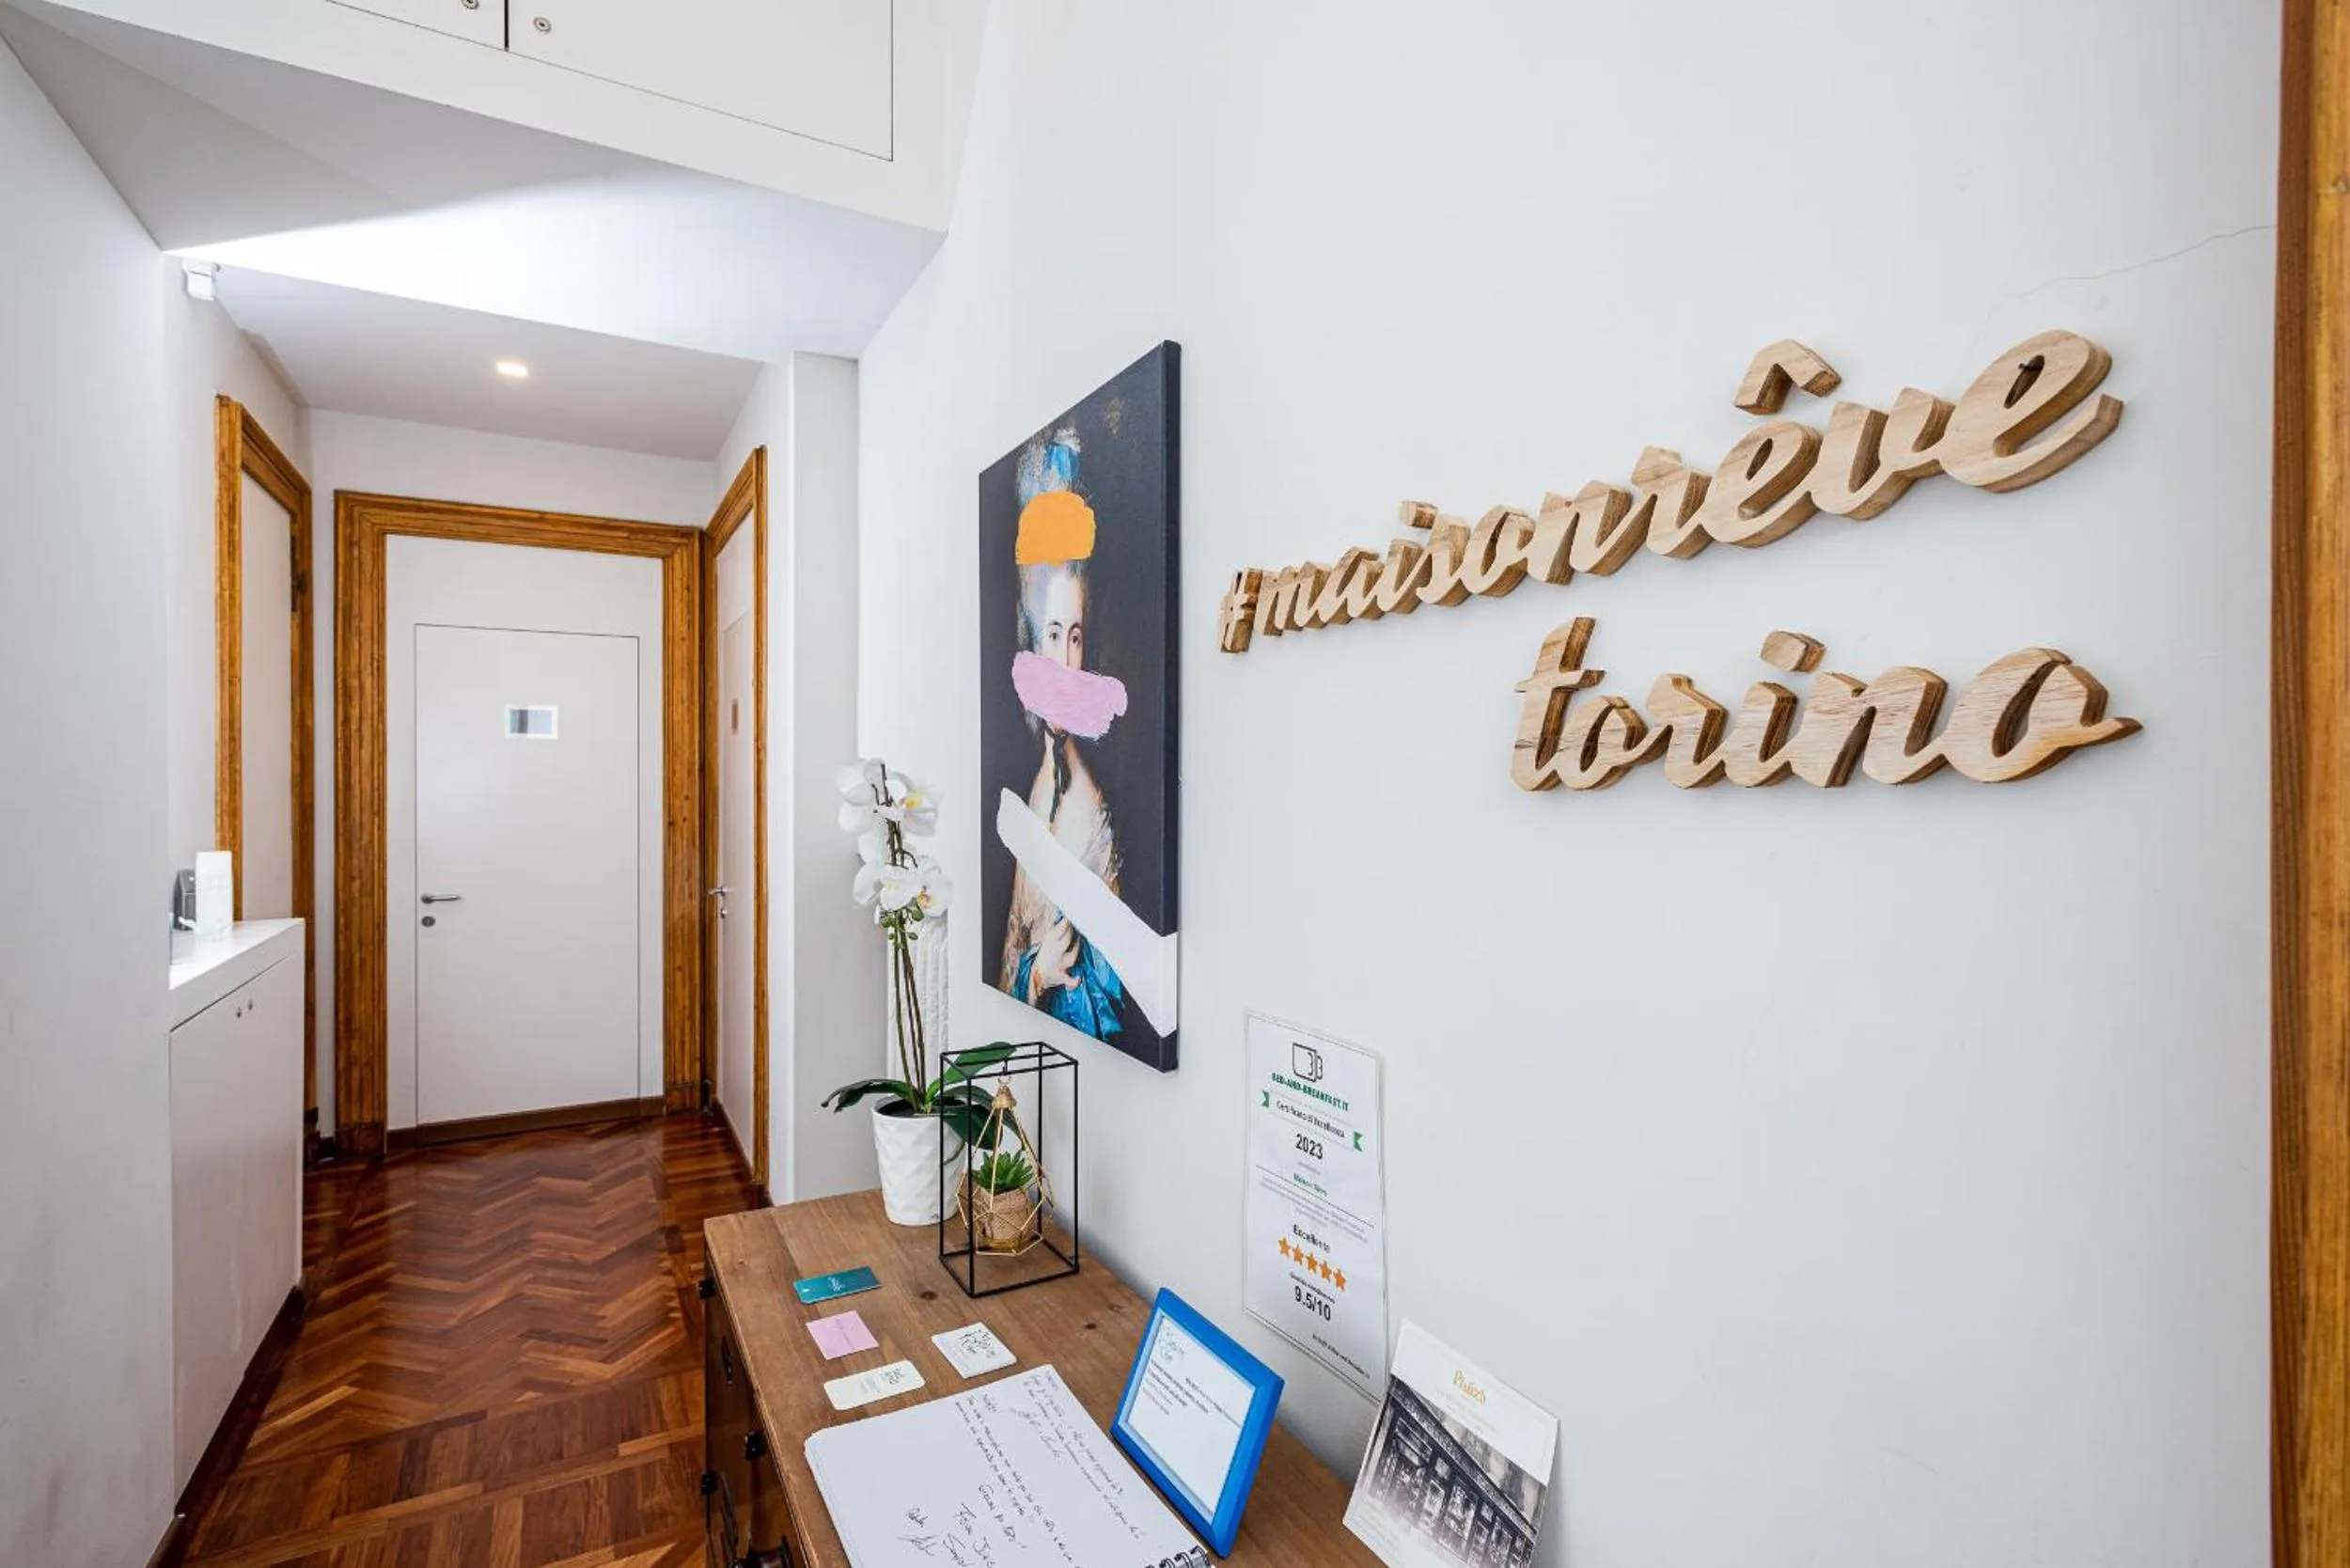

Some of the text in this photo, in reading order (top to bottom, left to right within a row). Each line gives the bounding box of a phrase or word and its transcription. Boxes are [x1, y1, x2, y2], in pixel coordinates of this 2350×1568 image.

[1218, 329, 2123, 653] #maisonrêve
[1510, 616, 2143, 792] torino
[1295, 1133, 1324, 1160] 2023
[1294, 1285, 1331, 1322] 9.5/10
